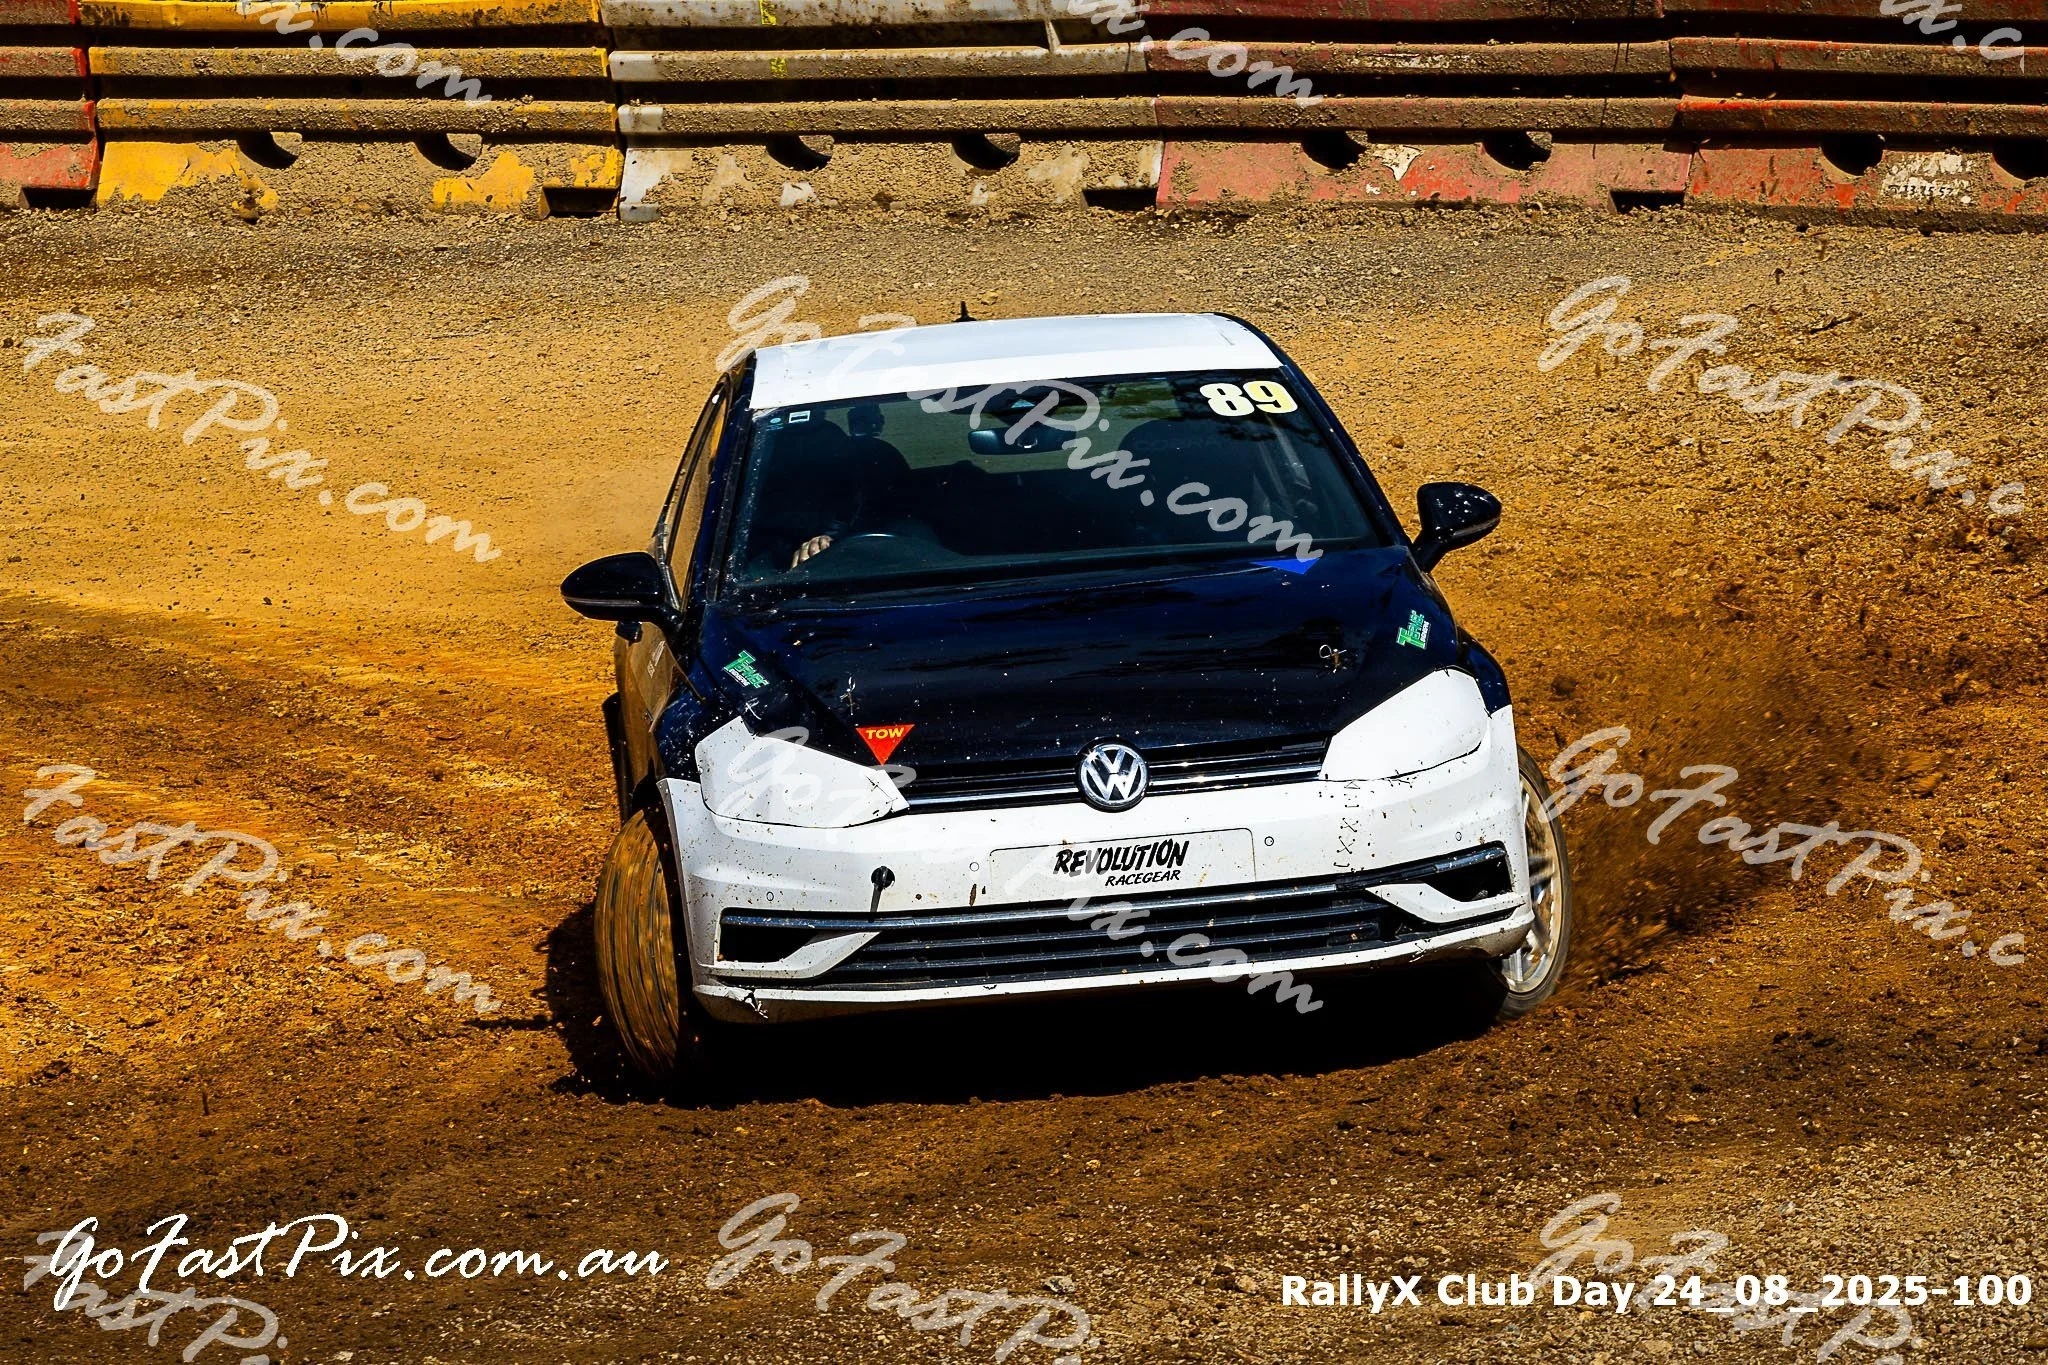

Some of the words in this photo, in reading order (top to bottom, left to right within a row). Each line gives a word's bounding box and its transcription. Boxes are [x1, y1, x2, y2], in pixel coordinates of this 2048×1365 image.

[1199, 380, 1299, 417] 89
[865, 726, 905, 740] TOW
[1081, 744, 1148, 804] VW
[1053, 838, 1190, 876] REVOLUTION
[1104, 869, 1181, 887] RACEGEAR
